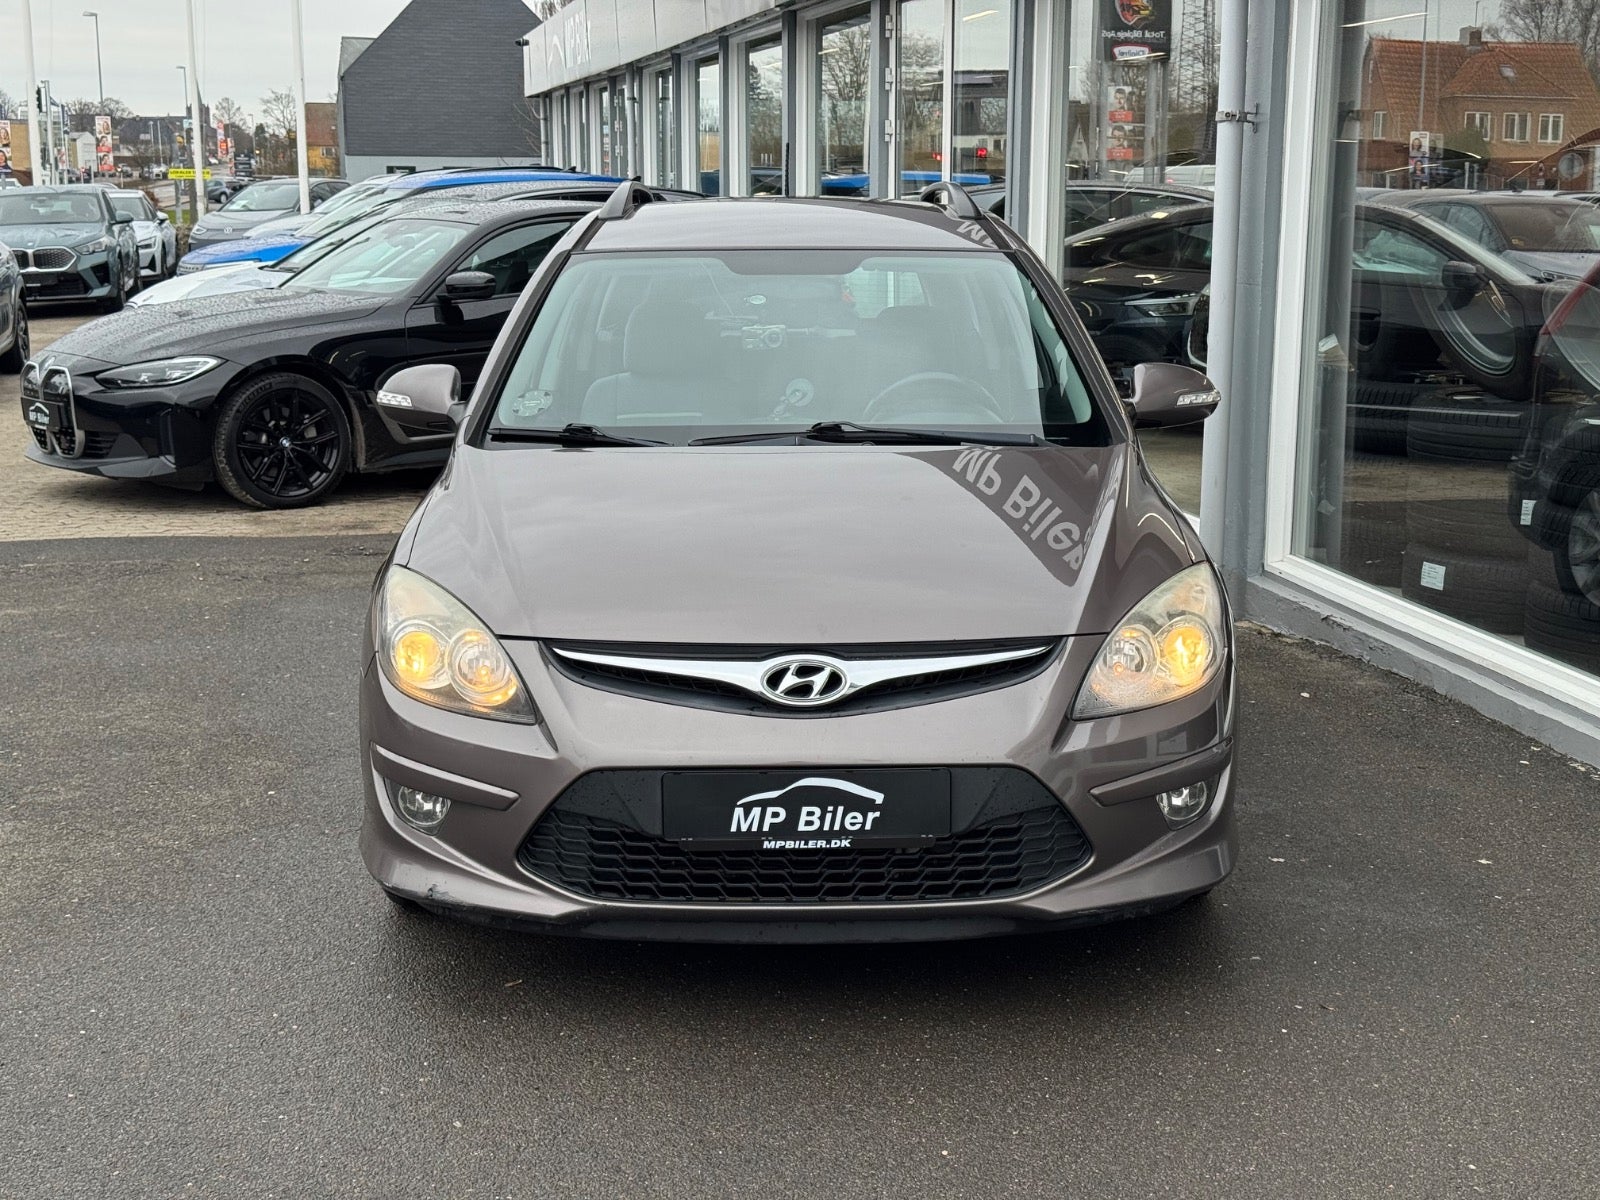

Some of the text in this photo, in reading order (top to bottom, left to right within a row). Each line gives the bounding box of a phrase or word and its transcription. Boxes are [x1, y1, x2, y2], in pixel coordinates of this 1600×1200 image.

[730, 806, 881, 832] MP Biler
[763, 838, 852, 849] MPBILER.DK
